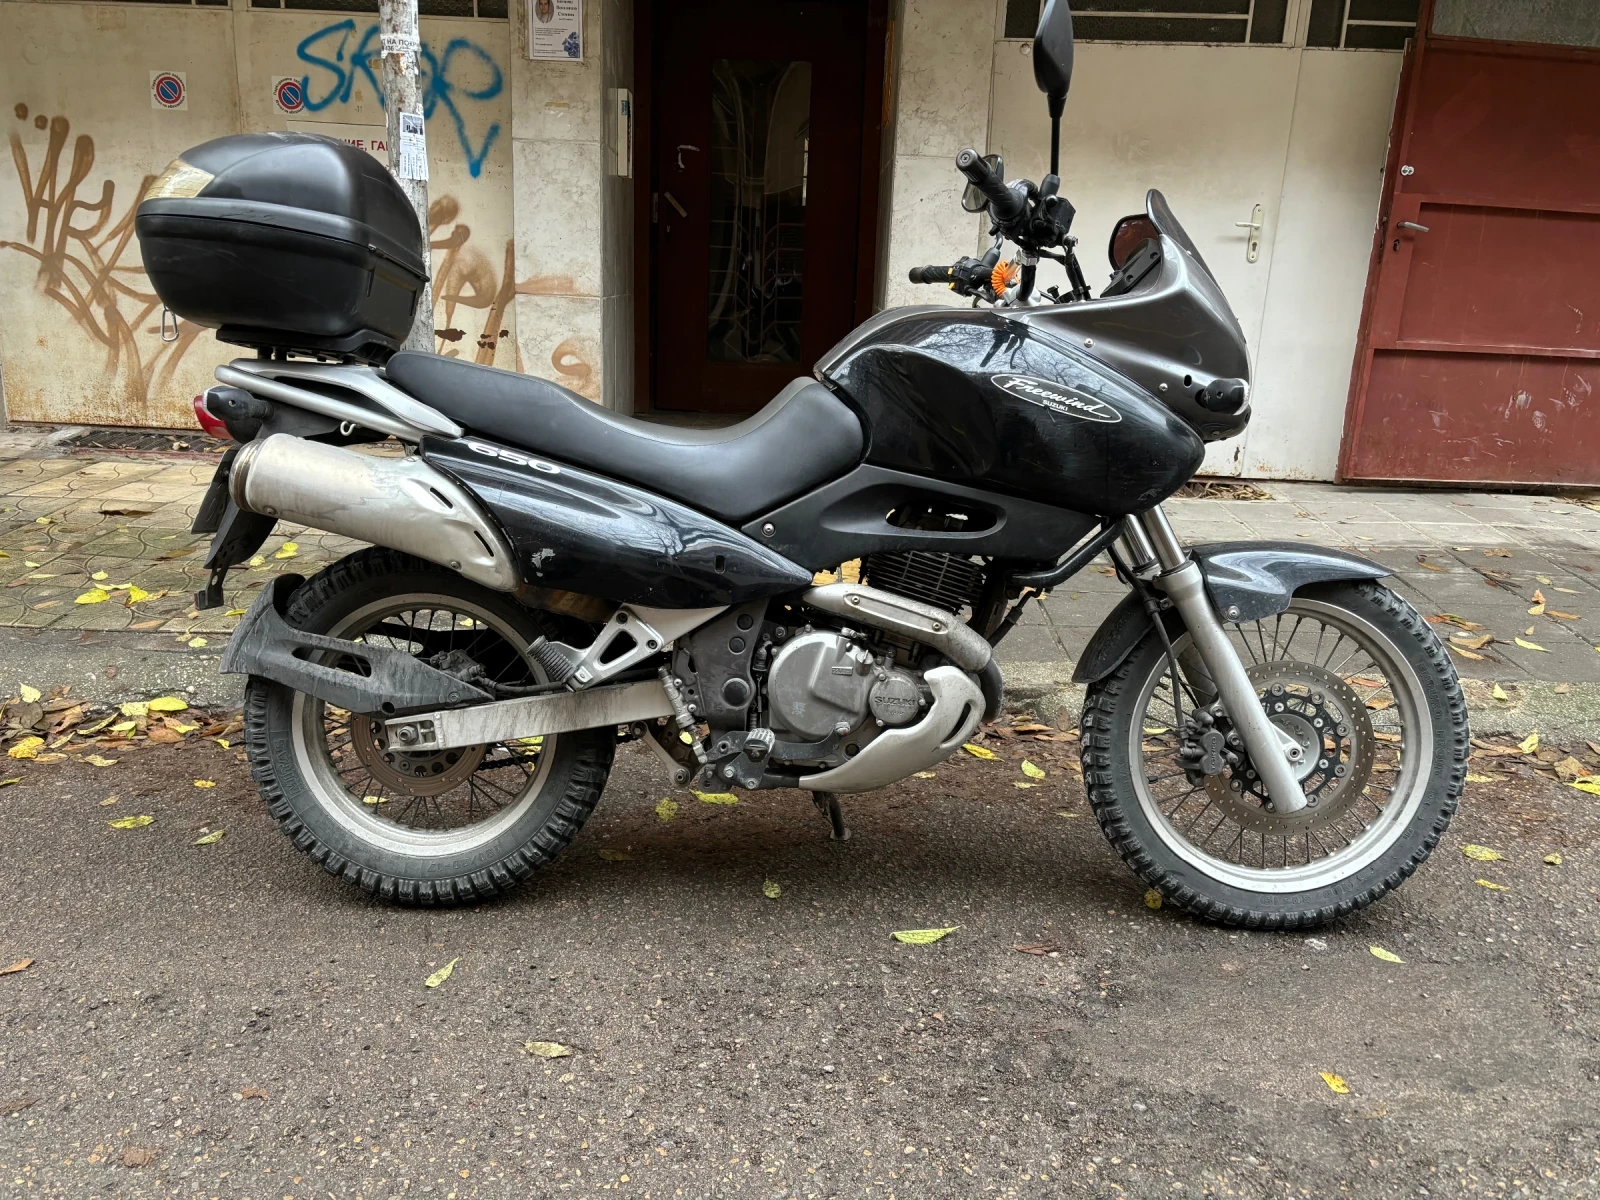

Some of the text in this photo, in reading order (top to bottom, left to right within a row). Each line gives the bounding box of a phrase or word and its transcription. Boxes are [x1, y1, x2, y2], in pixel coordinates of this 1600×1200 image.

[1002, 376, 1111, 418] Freewind
[1042, 399, 1069, 412] SUZUKI
[467, 441, 561, 474] 650
[874, 695, 916, 707] SUZUKI
